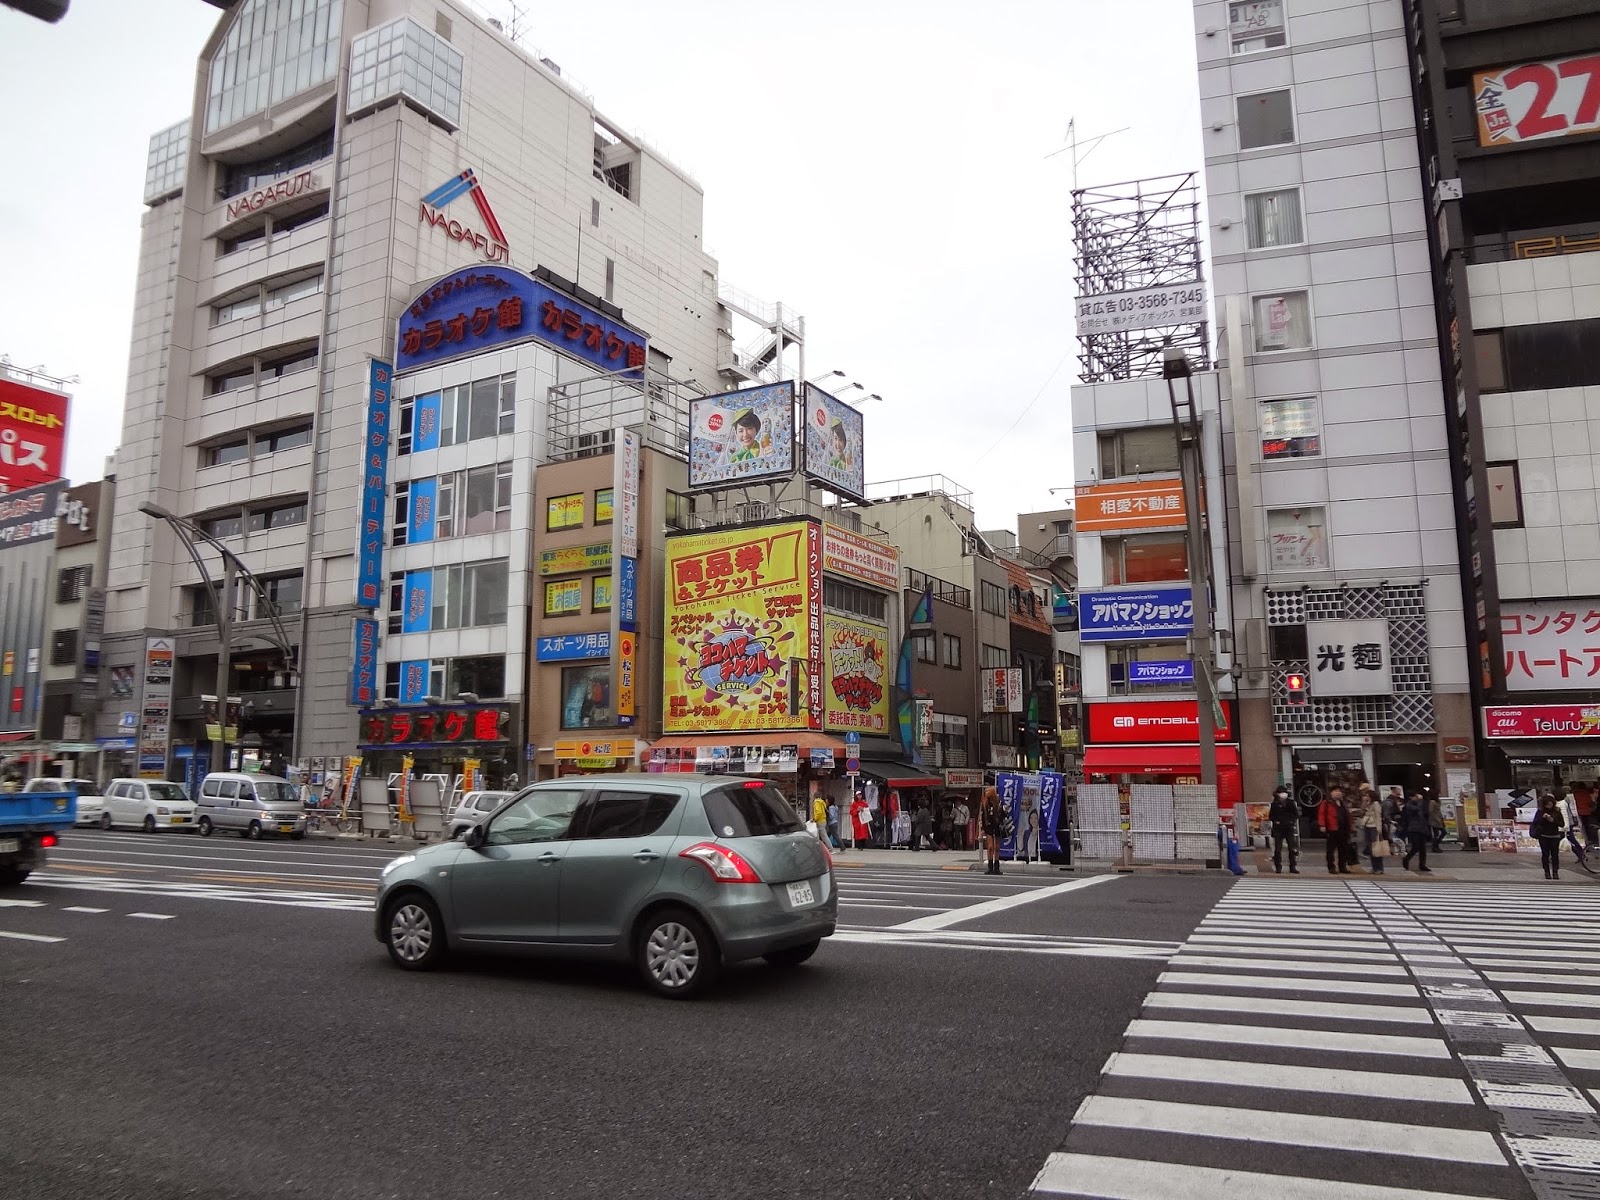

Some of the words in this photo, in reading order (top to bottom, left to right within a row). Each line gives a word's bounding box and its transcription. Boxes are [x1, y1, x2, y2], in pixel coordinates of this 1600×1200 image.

[226, 170, 313, 221] NAGAFUJI
[420, 204, 509, 263] NAGAFUJI
[1080, 300, 1118, 317] 貸広告
[1119, 288, 1203, 312] 03-3568-7345
[401, 296, 523, 355] カラオケ館
[541, 300, 646, 373] カラオケ館
[1100, 495, 1181, 515] 相愛不動産
[624, 524, 634, 536] 3F
[676, 545, 764, 586] 商品券
[674, 600, 721, 613] Yokohama
[726, 591, 758, 602] Ticket
[763, 582, 801, 595] Service
[677, 571, 765, 600] &チケット
[671, 612, 715, 625] スペシャル
[767, 607, 803, 618] サッカー
[542, 633, 609, 652] スポーツ用品
[671, 624, 702, 636] イベント
[357, 623, 374, 701] カラオケ館
[701, 635, 749, 667] ヨコハマ
[720, 651, 769, 680] チケット
[622, 658, 631, 687] 松屋
[717, 682, 748, 691] SERVICE
[670, 705, 720, 717] ミュージカル
[1497, 718, 1517, 727] au
[367, 710, 498, 742] カラオケ館
[594, 743, 612, 754] 松屋
